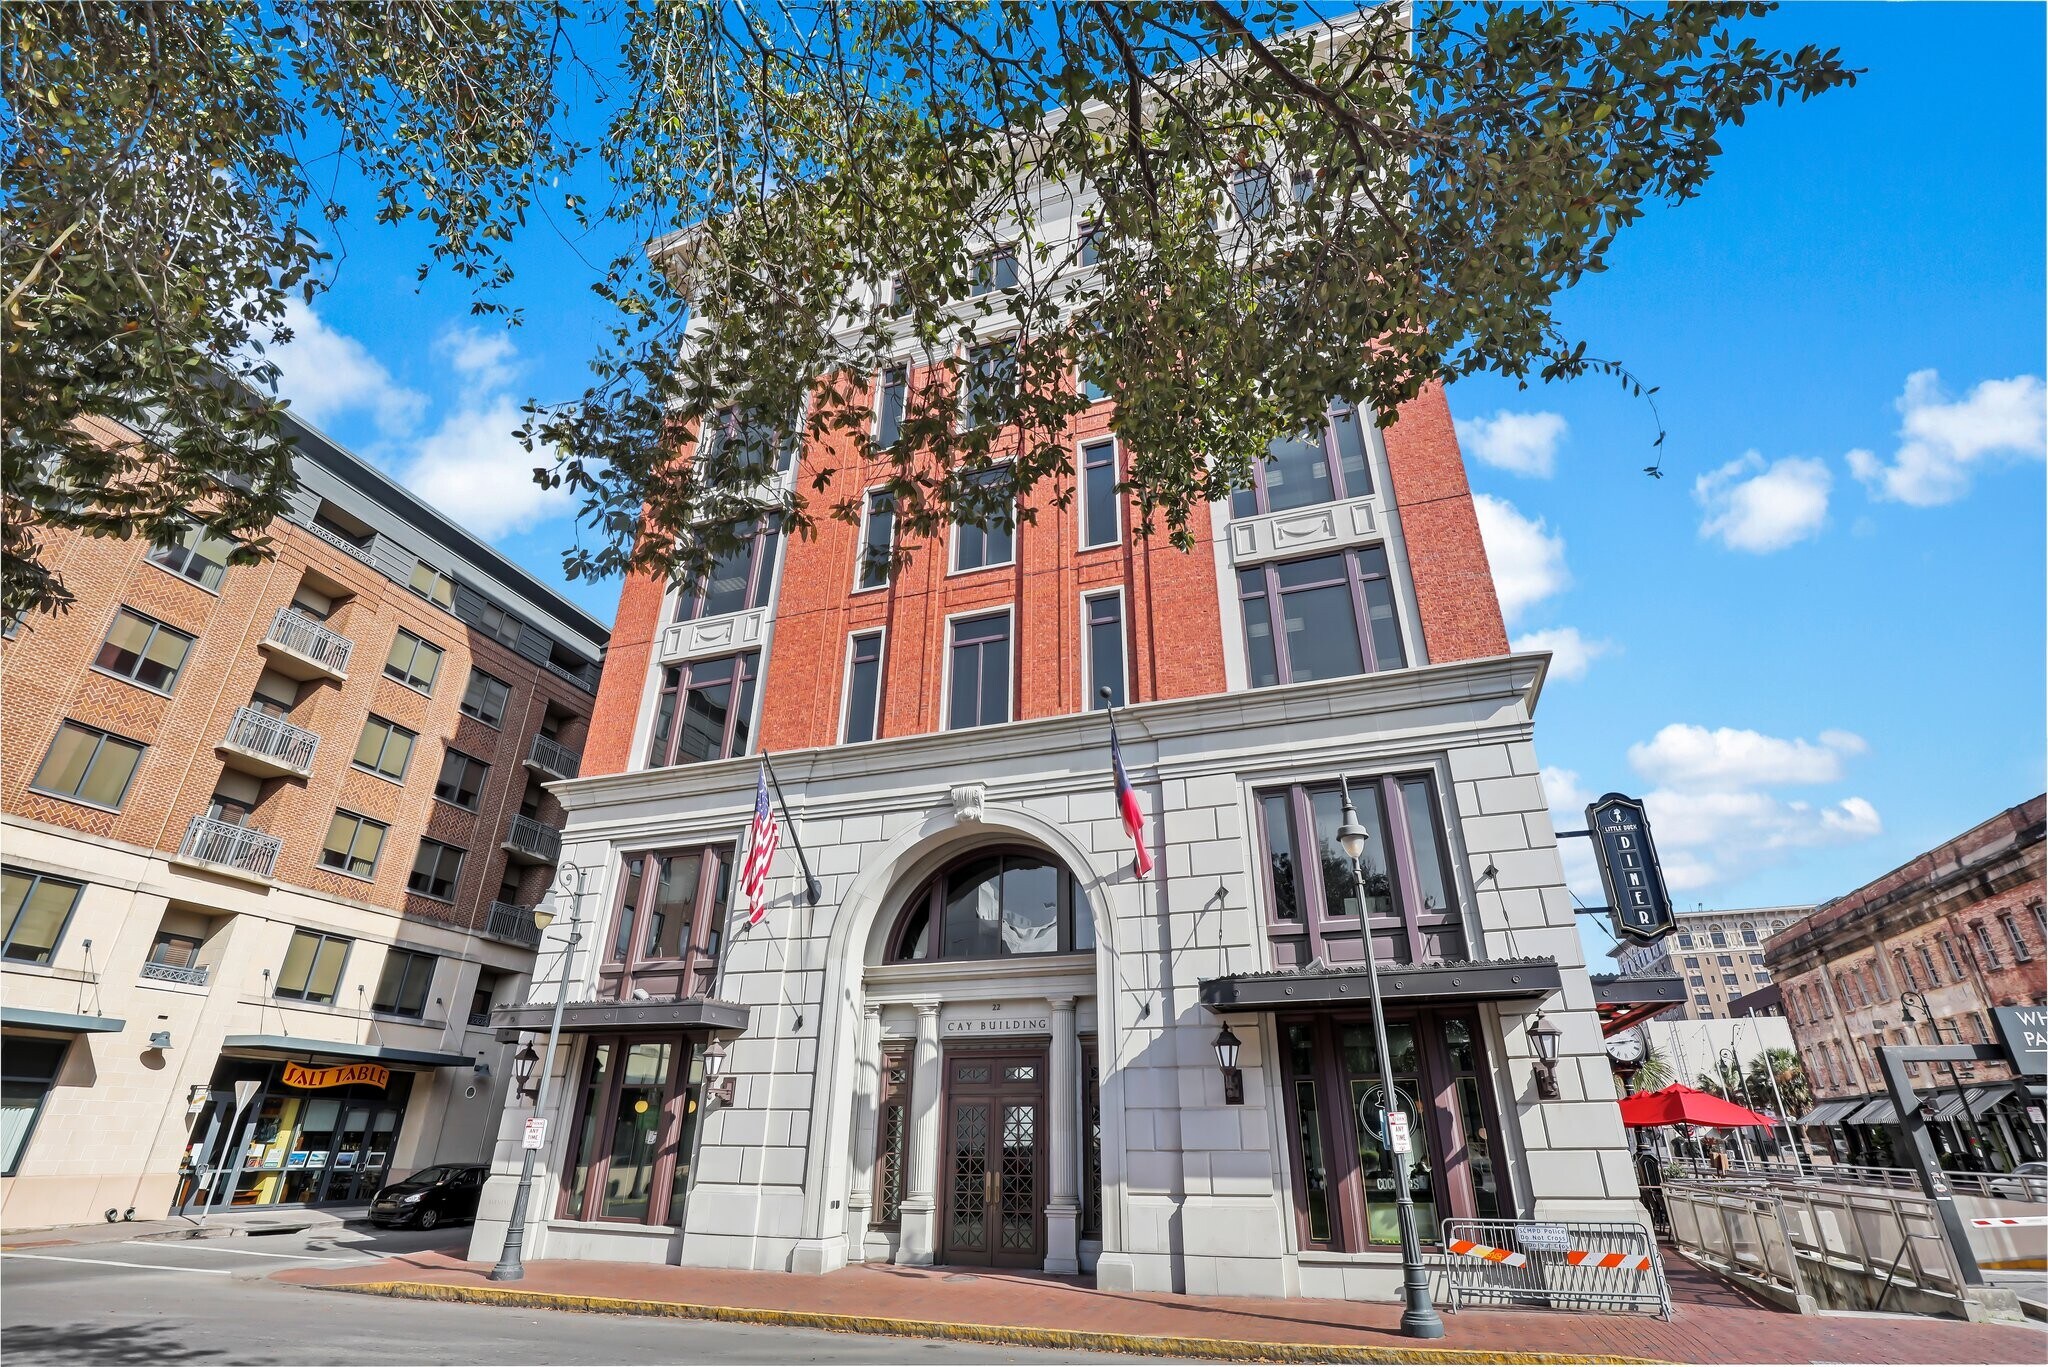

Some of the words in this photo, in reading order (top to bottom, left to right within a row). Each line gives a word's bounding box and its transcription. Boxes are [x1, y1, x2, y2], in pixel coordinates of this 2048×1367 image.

[1604, 824, 1621, 832] LITTLE
[1620, 836, 1650, 924] DINER
[947, 1022, 972, 1031] CAY
[980, 1020, 1046, 1030] BUILDING
[284, 1068, 329, 1086] SALT
[335, 1066, 387, 1085] TABLE
